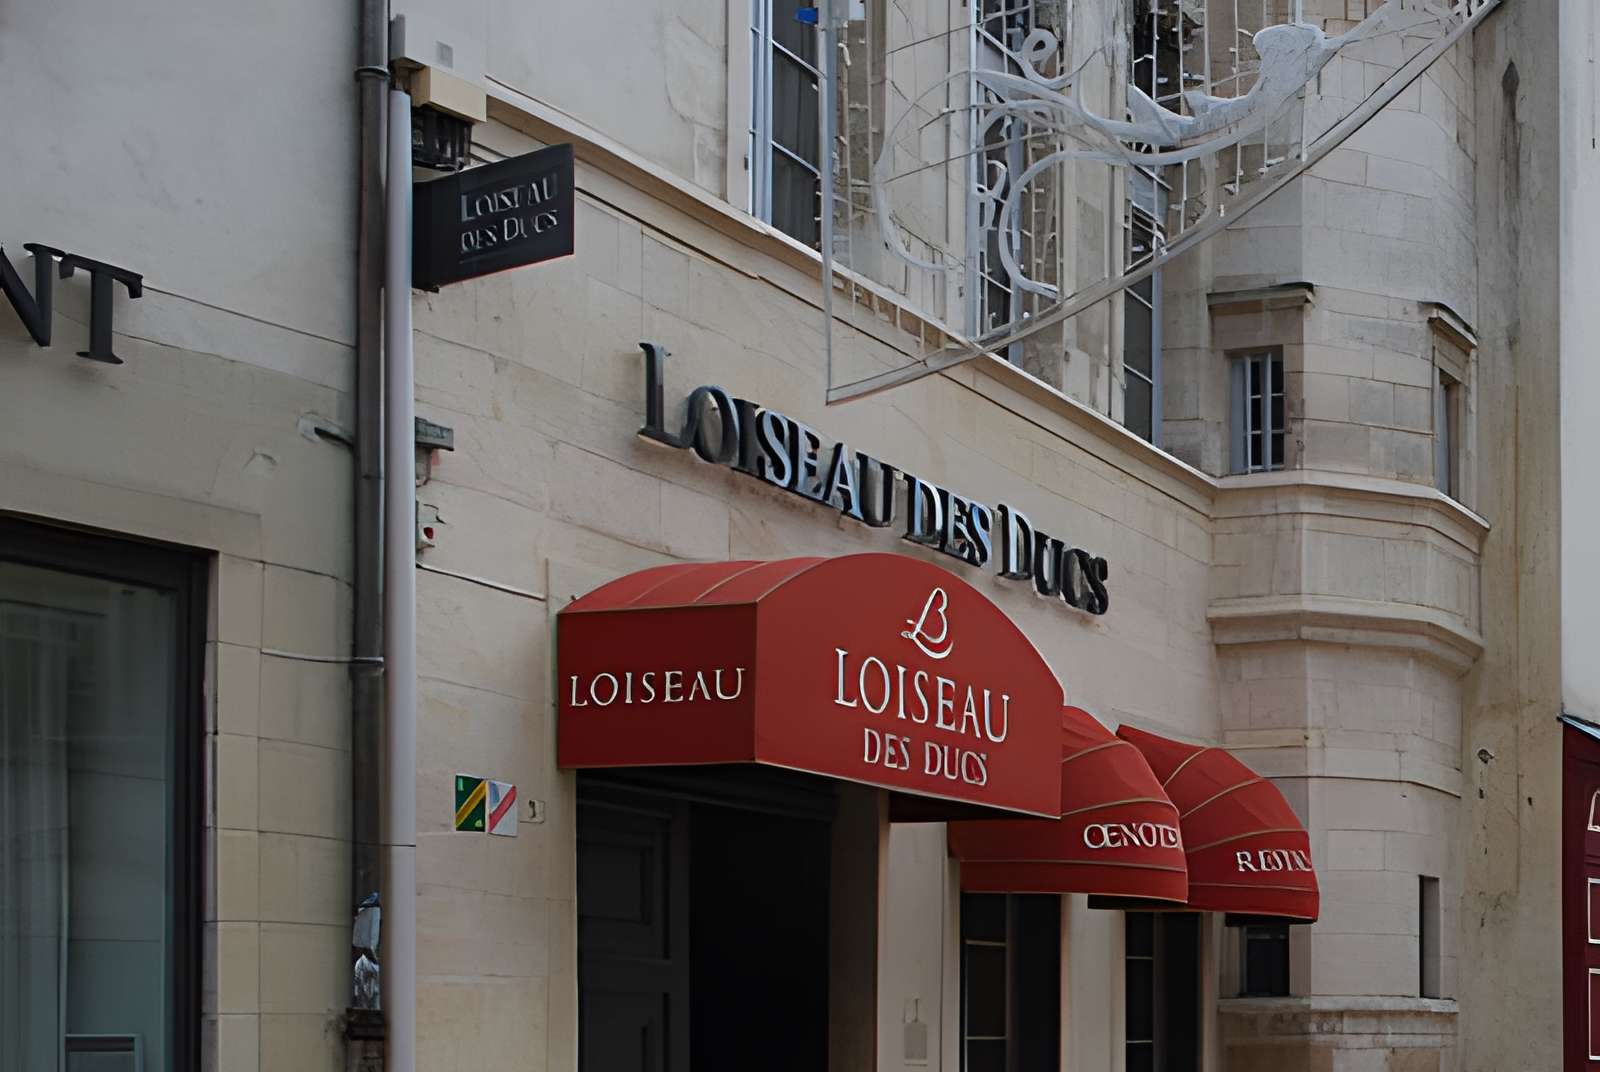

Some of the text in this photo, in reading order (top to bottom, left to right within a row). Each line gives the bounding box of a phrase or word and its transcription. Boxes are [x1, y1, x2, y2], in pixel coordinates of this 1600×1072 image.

[637, 342, 1110, 615] LOISEAU DES DUCS
[569, 667, 746, 708] LOISEAU
[834, 647, 1010, 743] LOISEAU
[863, 727, 988, 787] DES DUCS
